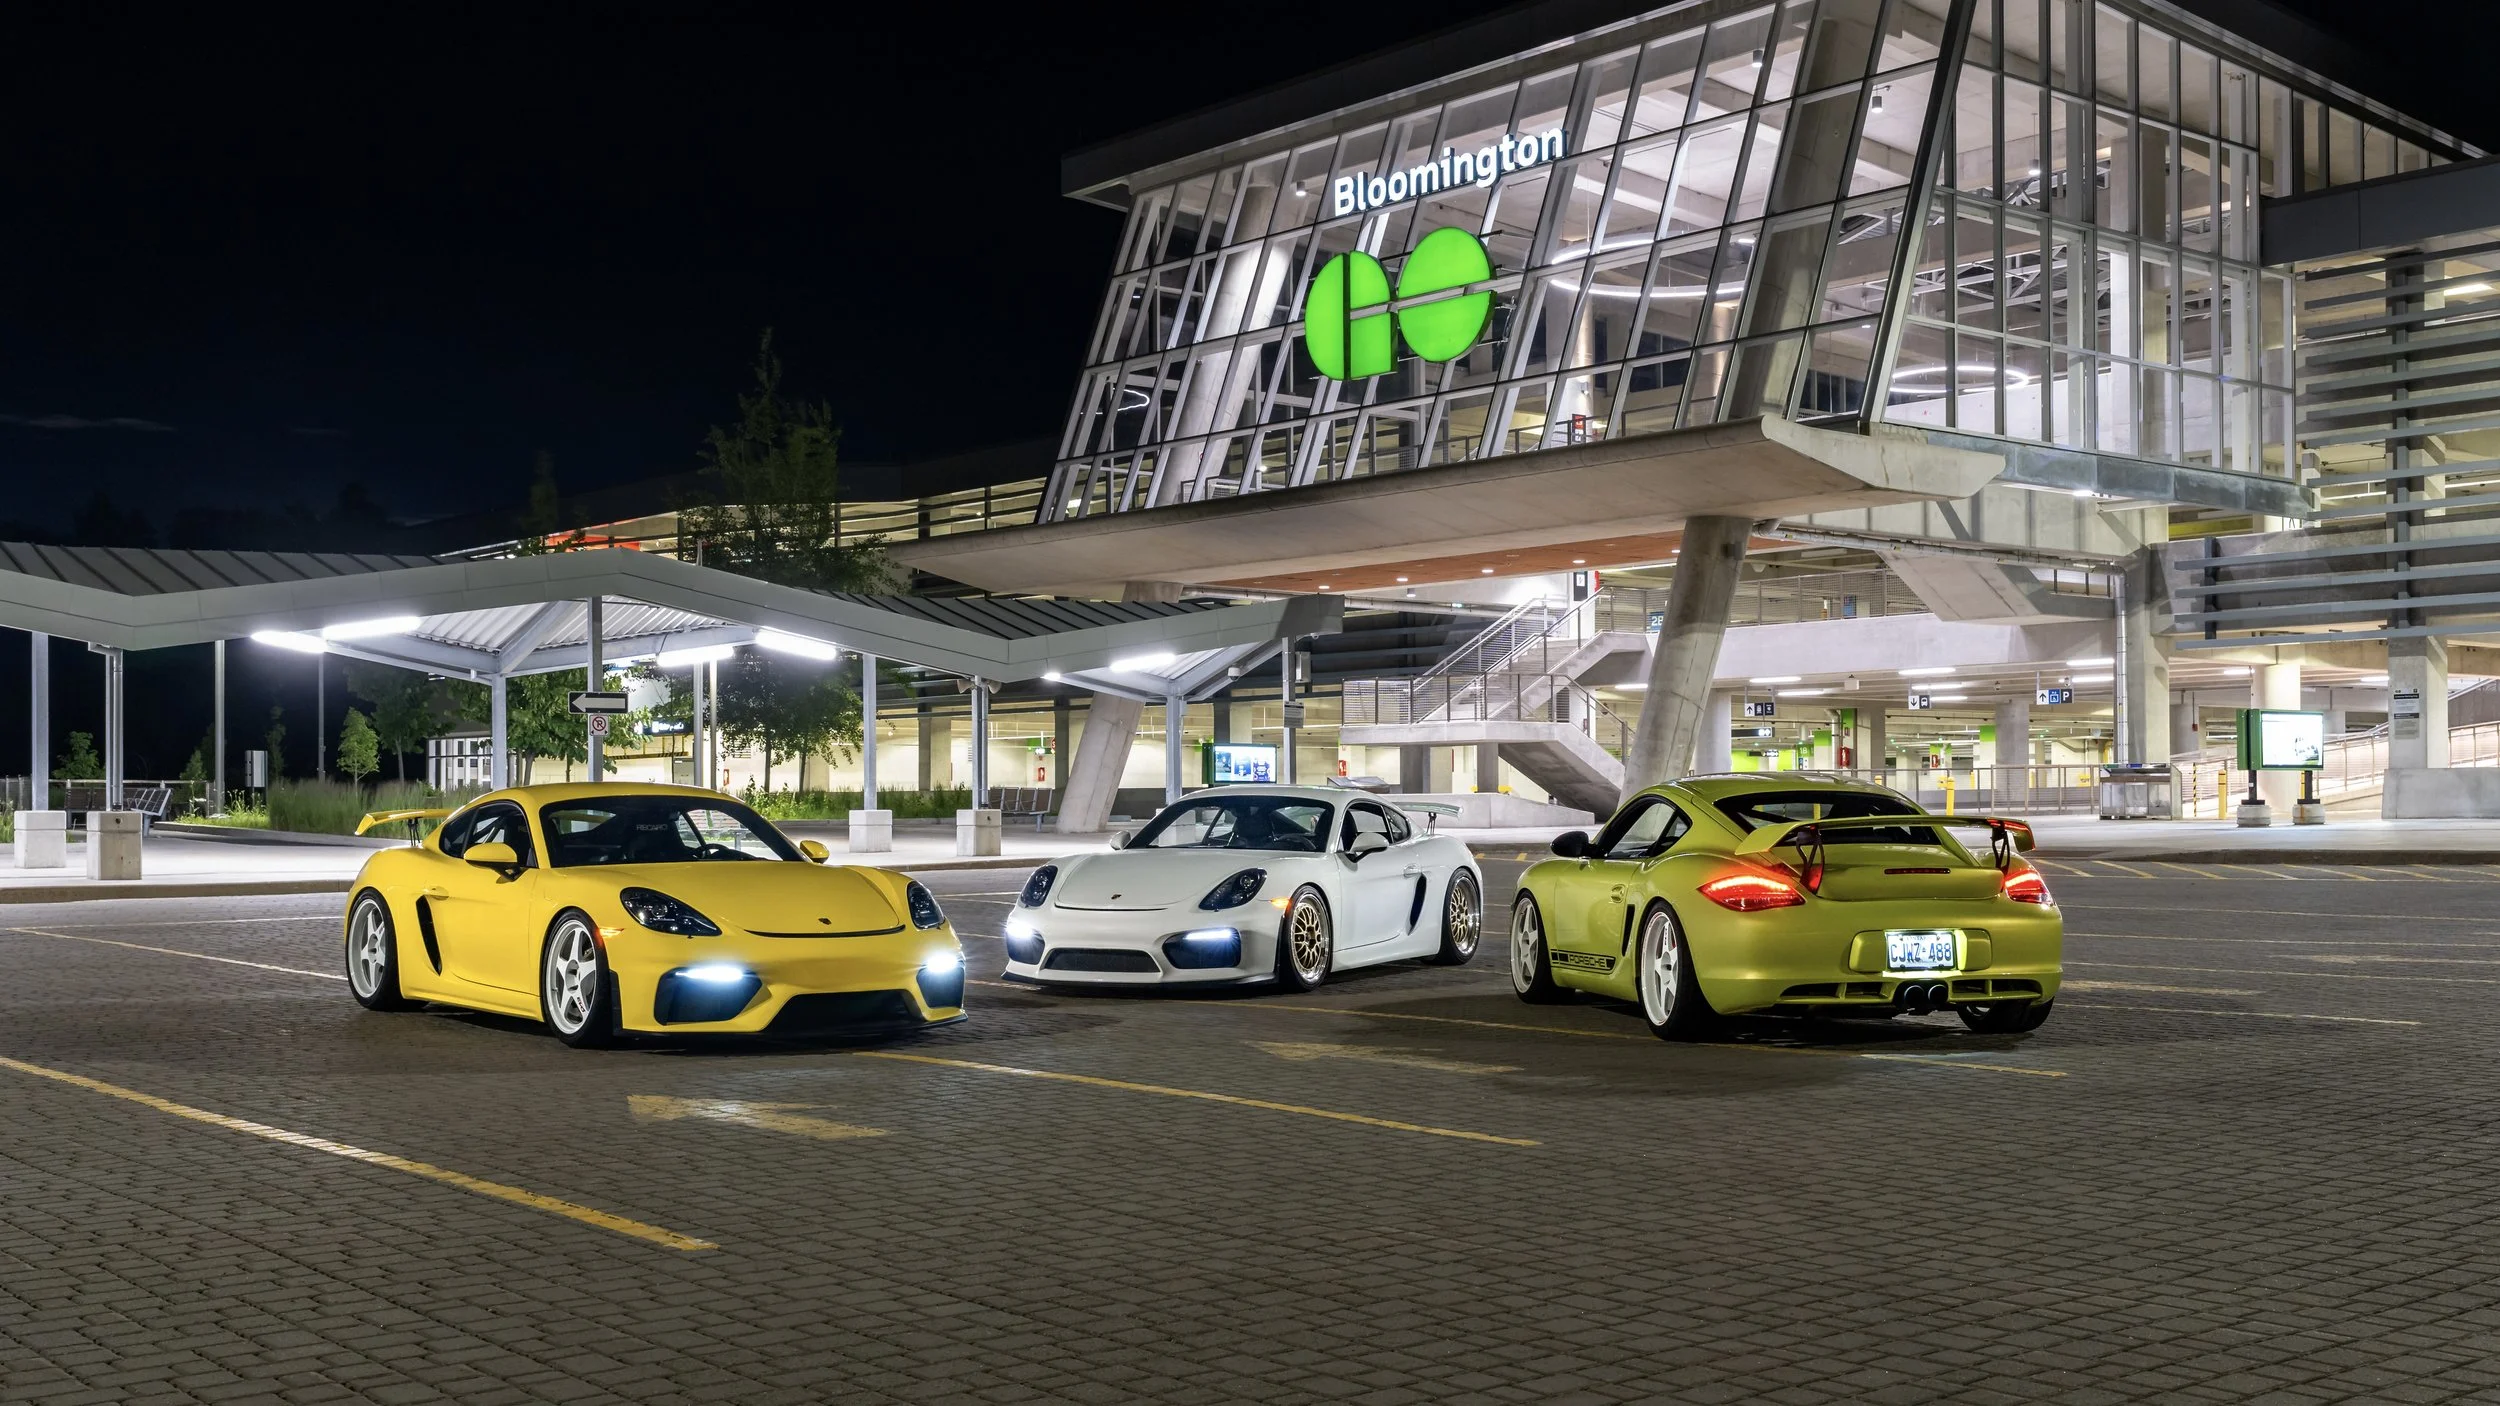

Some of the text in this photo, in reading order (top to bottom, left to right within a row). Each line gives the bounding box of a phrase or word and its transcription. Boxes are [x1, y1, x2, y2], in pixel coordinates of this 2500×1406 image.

[1335, 127, 1564, 216] Bloomington
[2063, 691, 2070, 701] P
[635, 823, 669, 832] RECARO
[1569, 953, 1607, 968] PORSCHE
